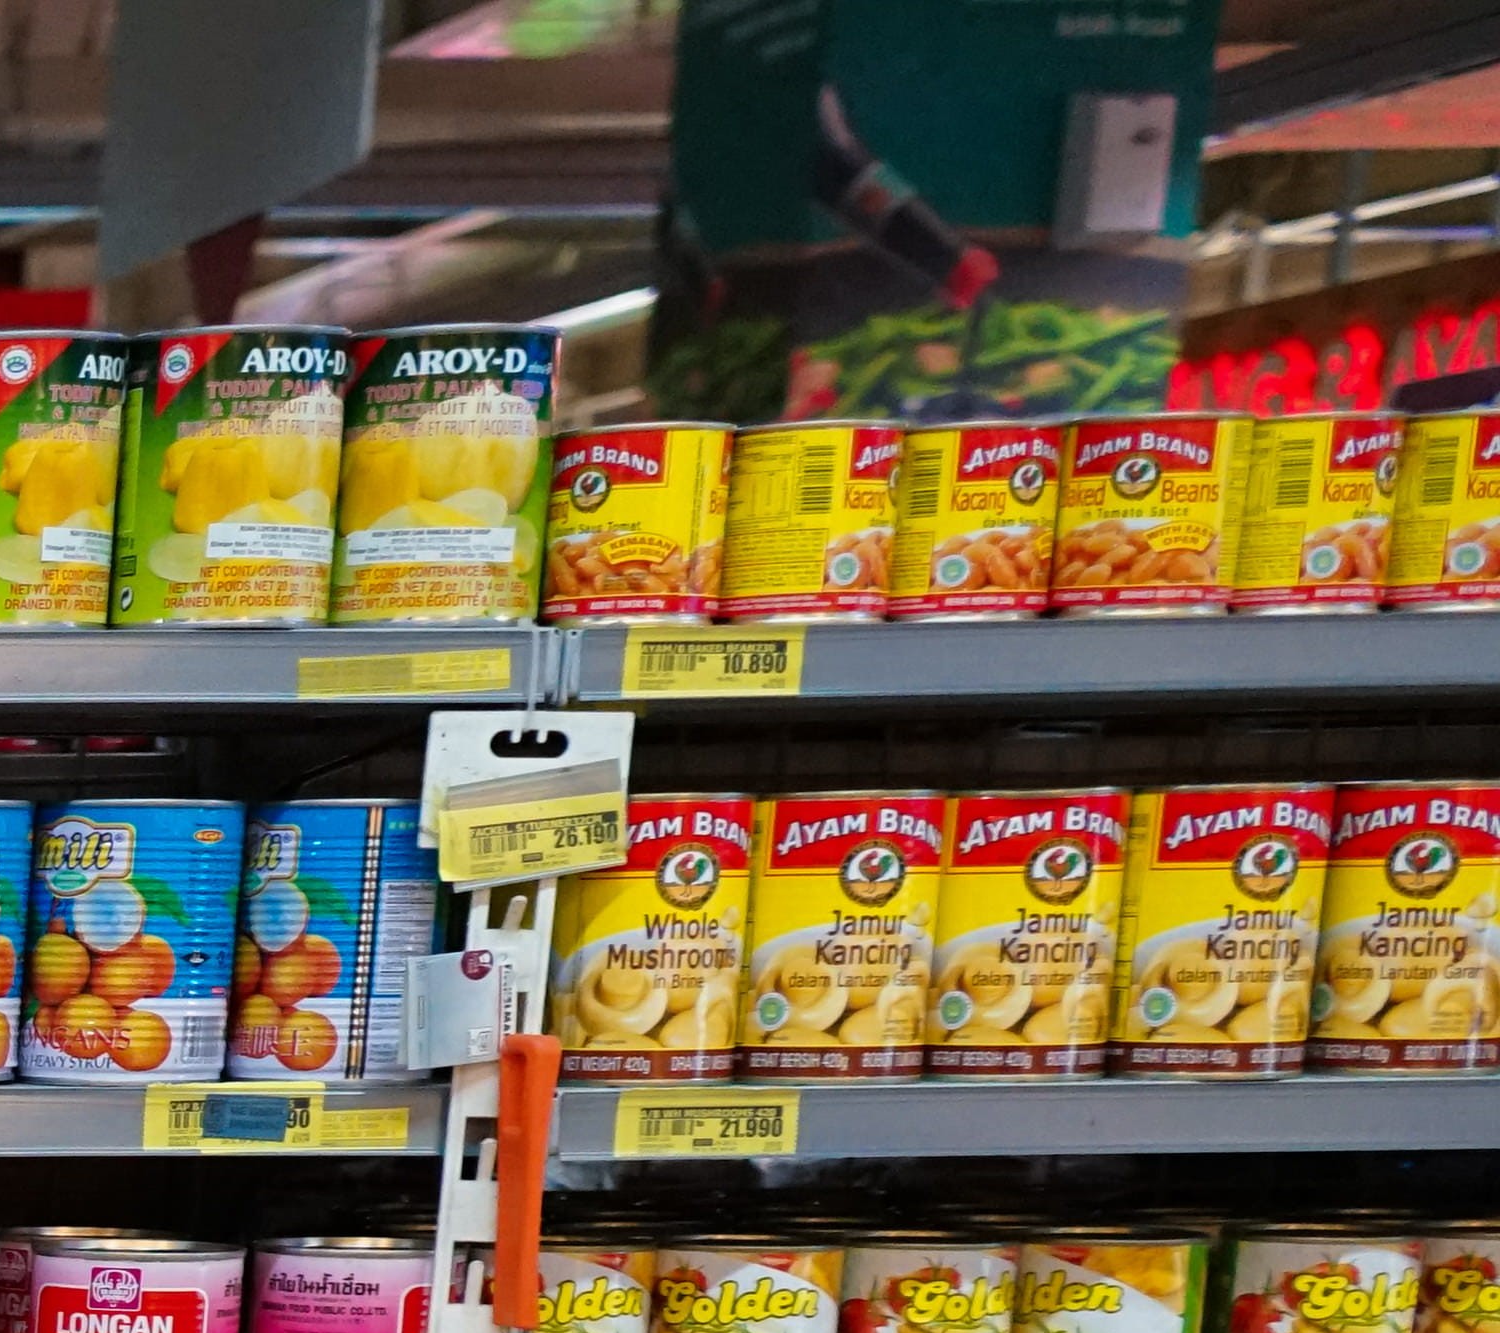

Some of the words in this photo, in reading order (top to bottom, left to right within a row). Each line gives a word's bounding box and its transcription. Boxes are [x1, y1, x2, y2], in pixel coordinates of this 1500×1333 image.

[1078, 437, 1132, 466] AYAM
[1140, 433, 1208, 464] BRAND
[1161, 479, 1219, 500] Beans
[722, 652, 787, 673] 10.890
[555, 824, 617, 847] 26.190
[645, 913, 718, 938] Whole
[832, 909, 906, 936] Jamur
[608, 943, 735, 970] Mushrooms
[816, 937, 910, 965] Kancing
[720, 1118, 783, 1138] 21.990
[660, 1277, 818, 1324] Golden
